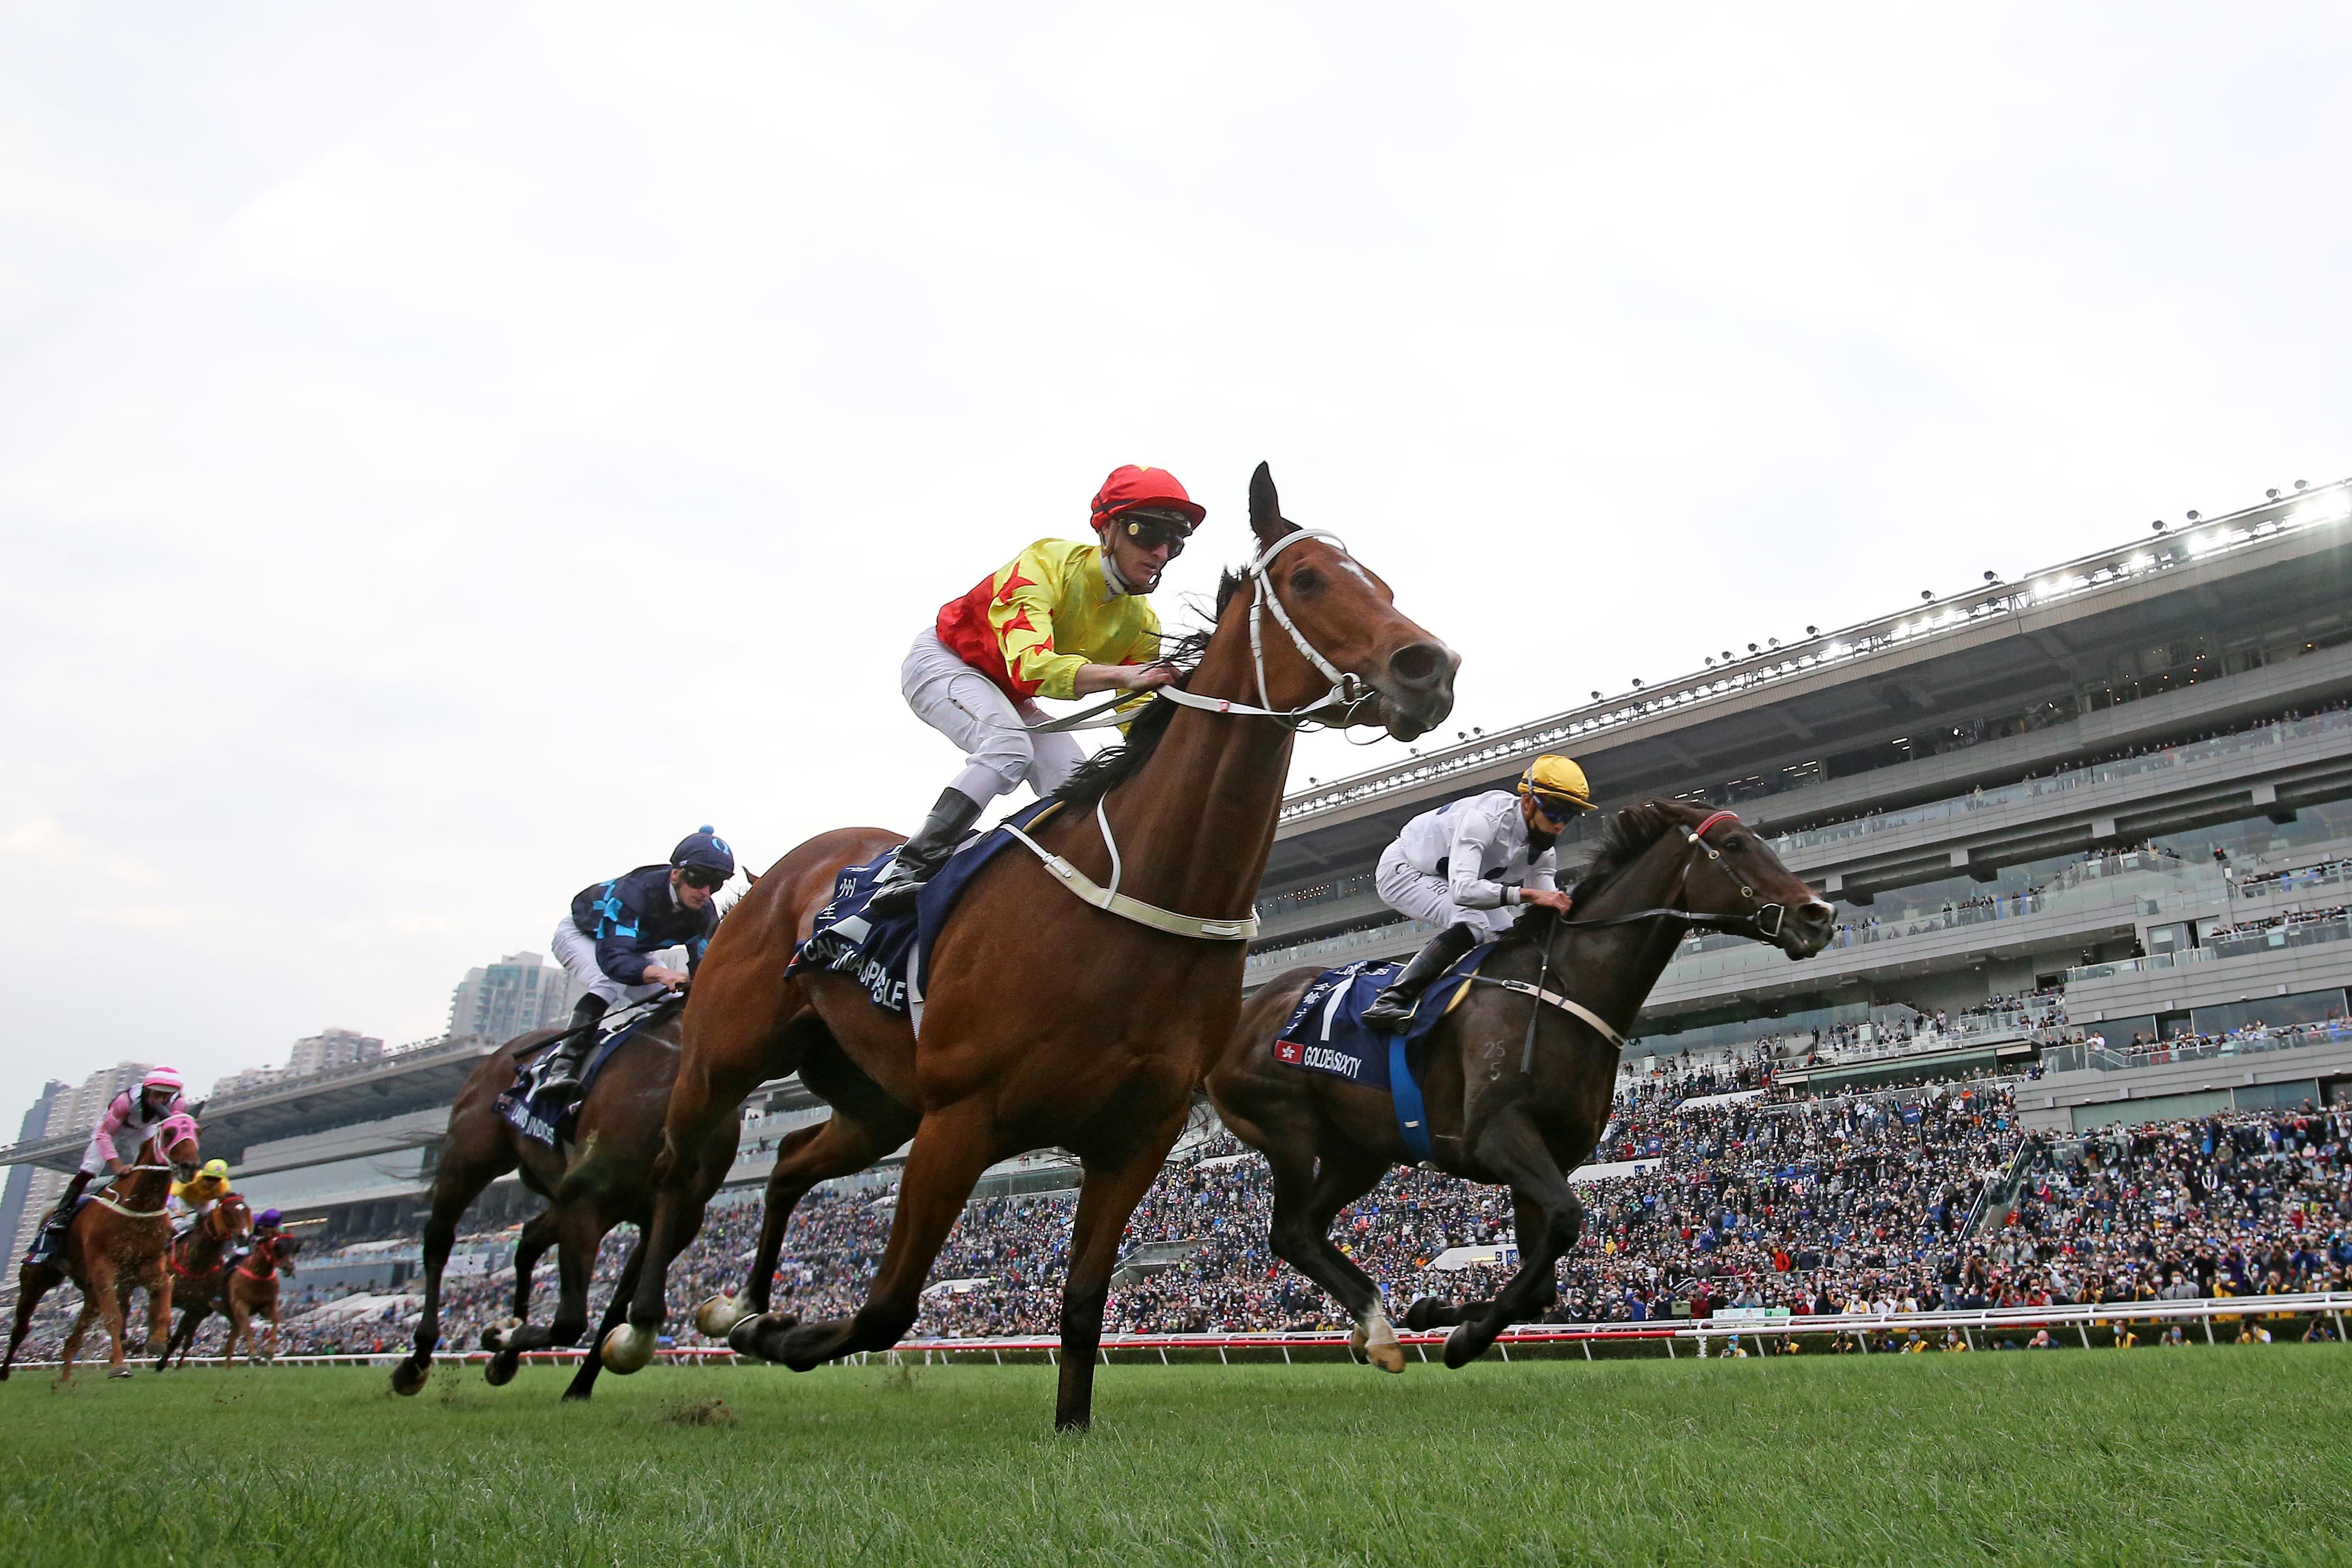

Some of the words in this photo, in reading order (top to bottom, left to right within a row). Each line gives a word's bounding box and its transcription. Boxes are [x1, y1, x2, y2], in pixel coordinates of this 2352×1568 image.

[1395, 863, 1410, 875] C
[1426, 880, 1449, 895] Ho
[1320, 973, 1357, 1042] 1
[1333, 1051, 1362, 1079] SIXTY
